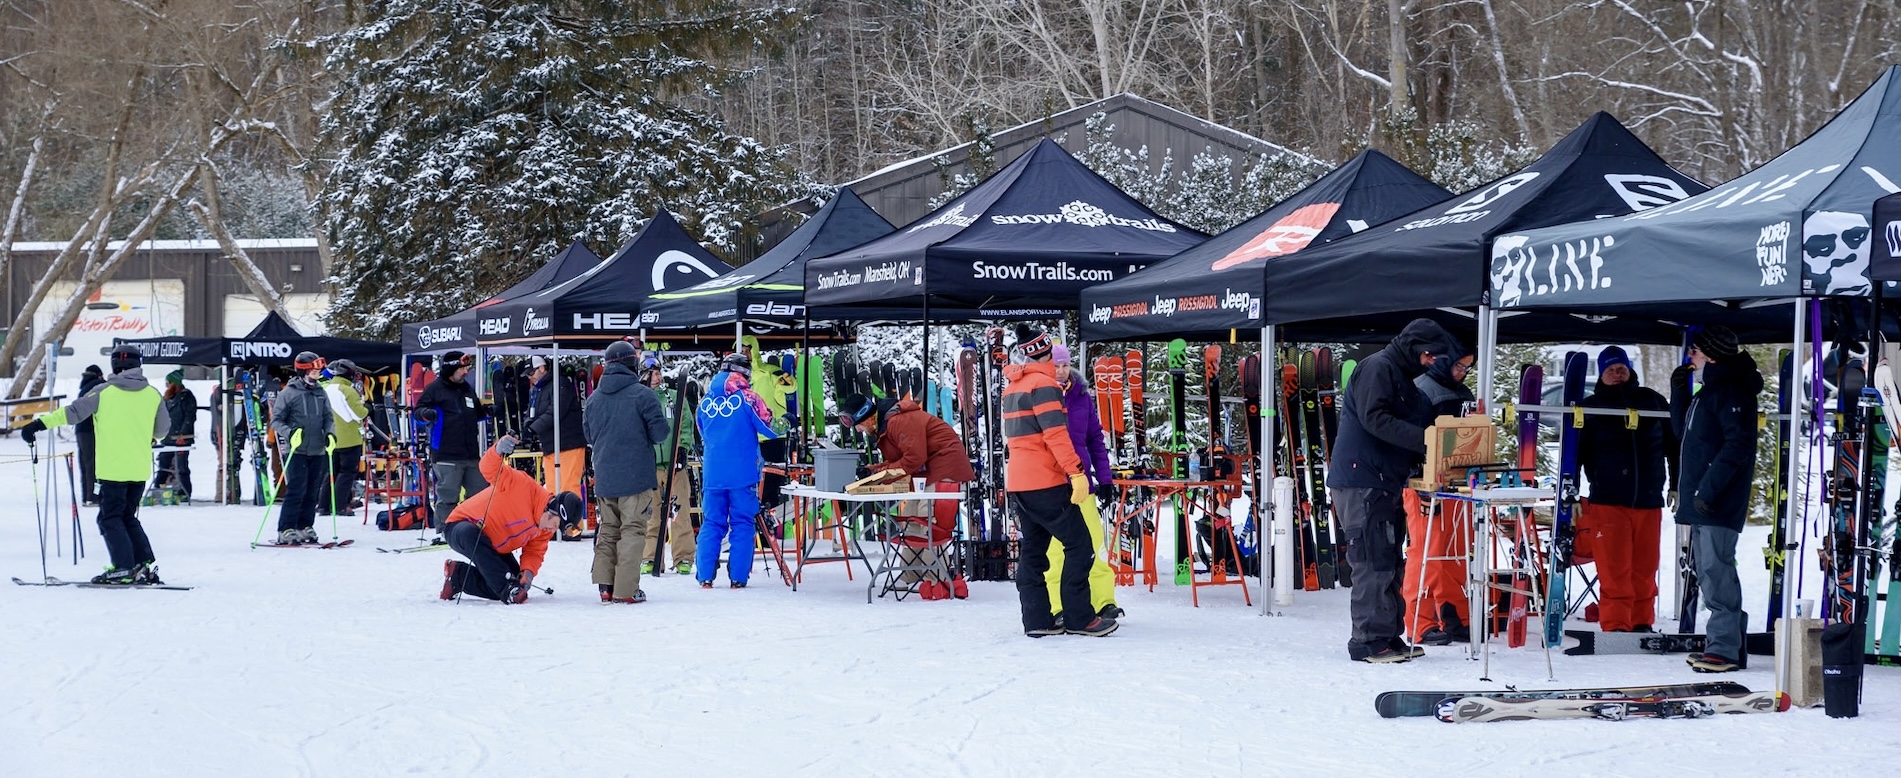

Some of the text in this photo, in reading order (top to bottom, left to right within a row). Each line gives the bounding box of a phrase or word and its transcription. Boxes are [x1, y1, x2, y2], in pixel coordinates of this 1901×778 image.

[991, 213, 1177, 233] snow trails
[973, 261, 1113, 281] SnowTrails.com
[1524, 235, 1615, 296] LINE
[817, 269, 861, 290] SnowTrails.com
[863, 261, 897, 284] Mansfield,
[897, 260, 911, 279] OH
[745, 300, 806, 316] elan
[1089, 304, 1111, 325] Jeep
[1112, 302, 1148, 319] ROSSIGNOL
[1151, 295, 1176, 318] Jeep
[1178, 295, 1217, 312] ROSSIGNOL
[1221, 288, 1250, 313] Jeep
[641, 310, 660, 323] elan
[432, 326, 462, 343] SUBARU
[479, 318, 511, 335] HEAD
[245, 341, 293, 358] NITRO
